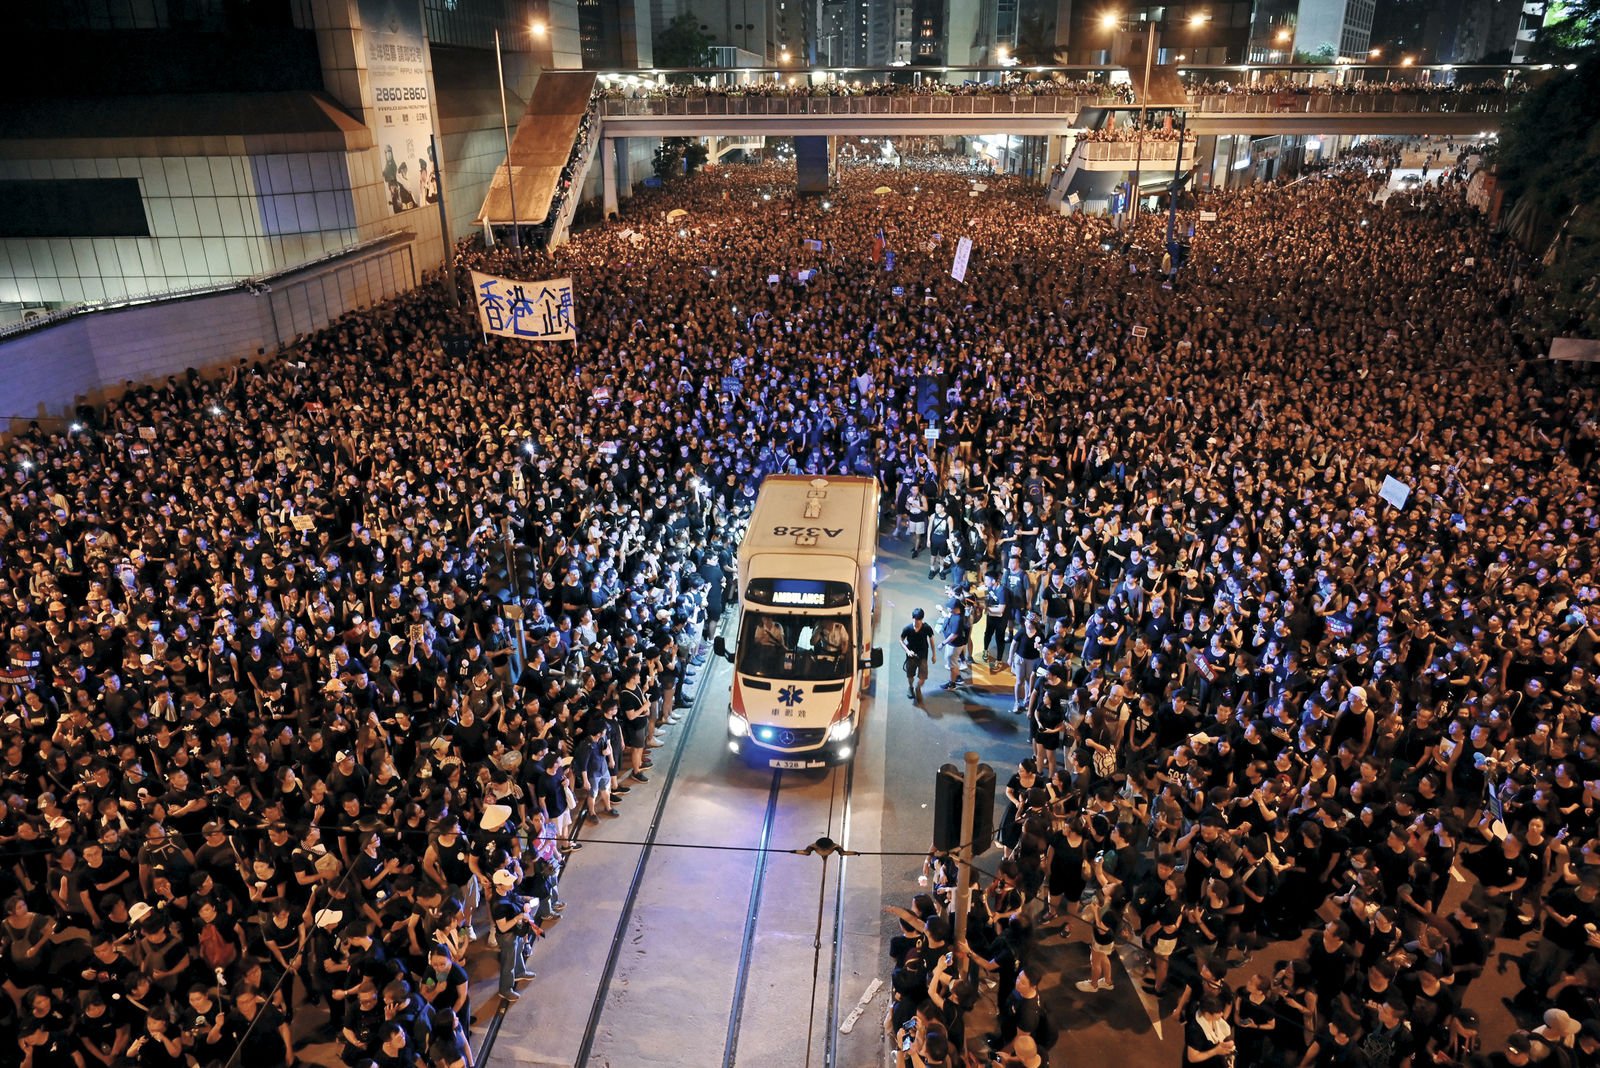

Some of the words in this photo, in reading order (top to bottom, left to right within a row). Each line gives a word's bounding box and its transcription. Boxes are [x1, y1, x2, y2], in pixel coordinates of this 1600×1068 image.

[375, 87, 402, 101] 2860
[403, 87, 426, 100] 2860
[773, 526, 844, 538] A328
[772, 592, 825, 604] AMBULANCE
